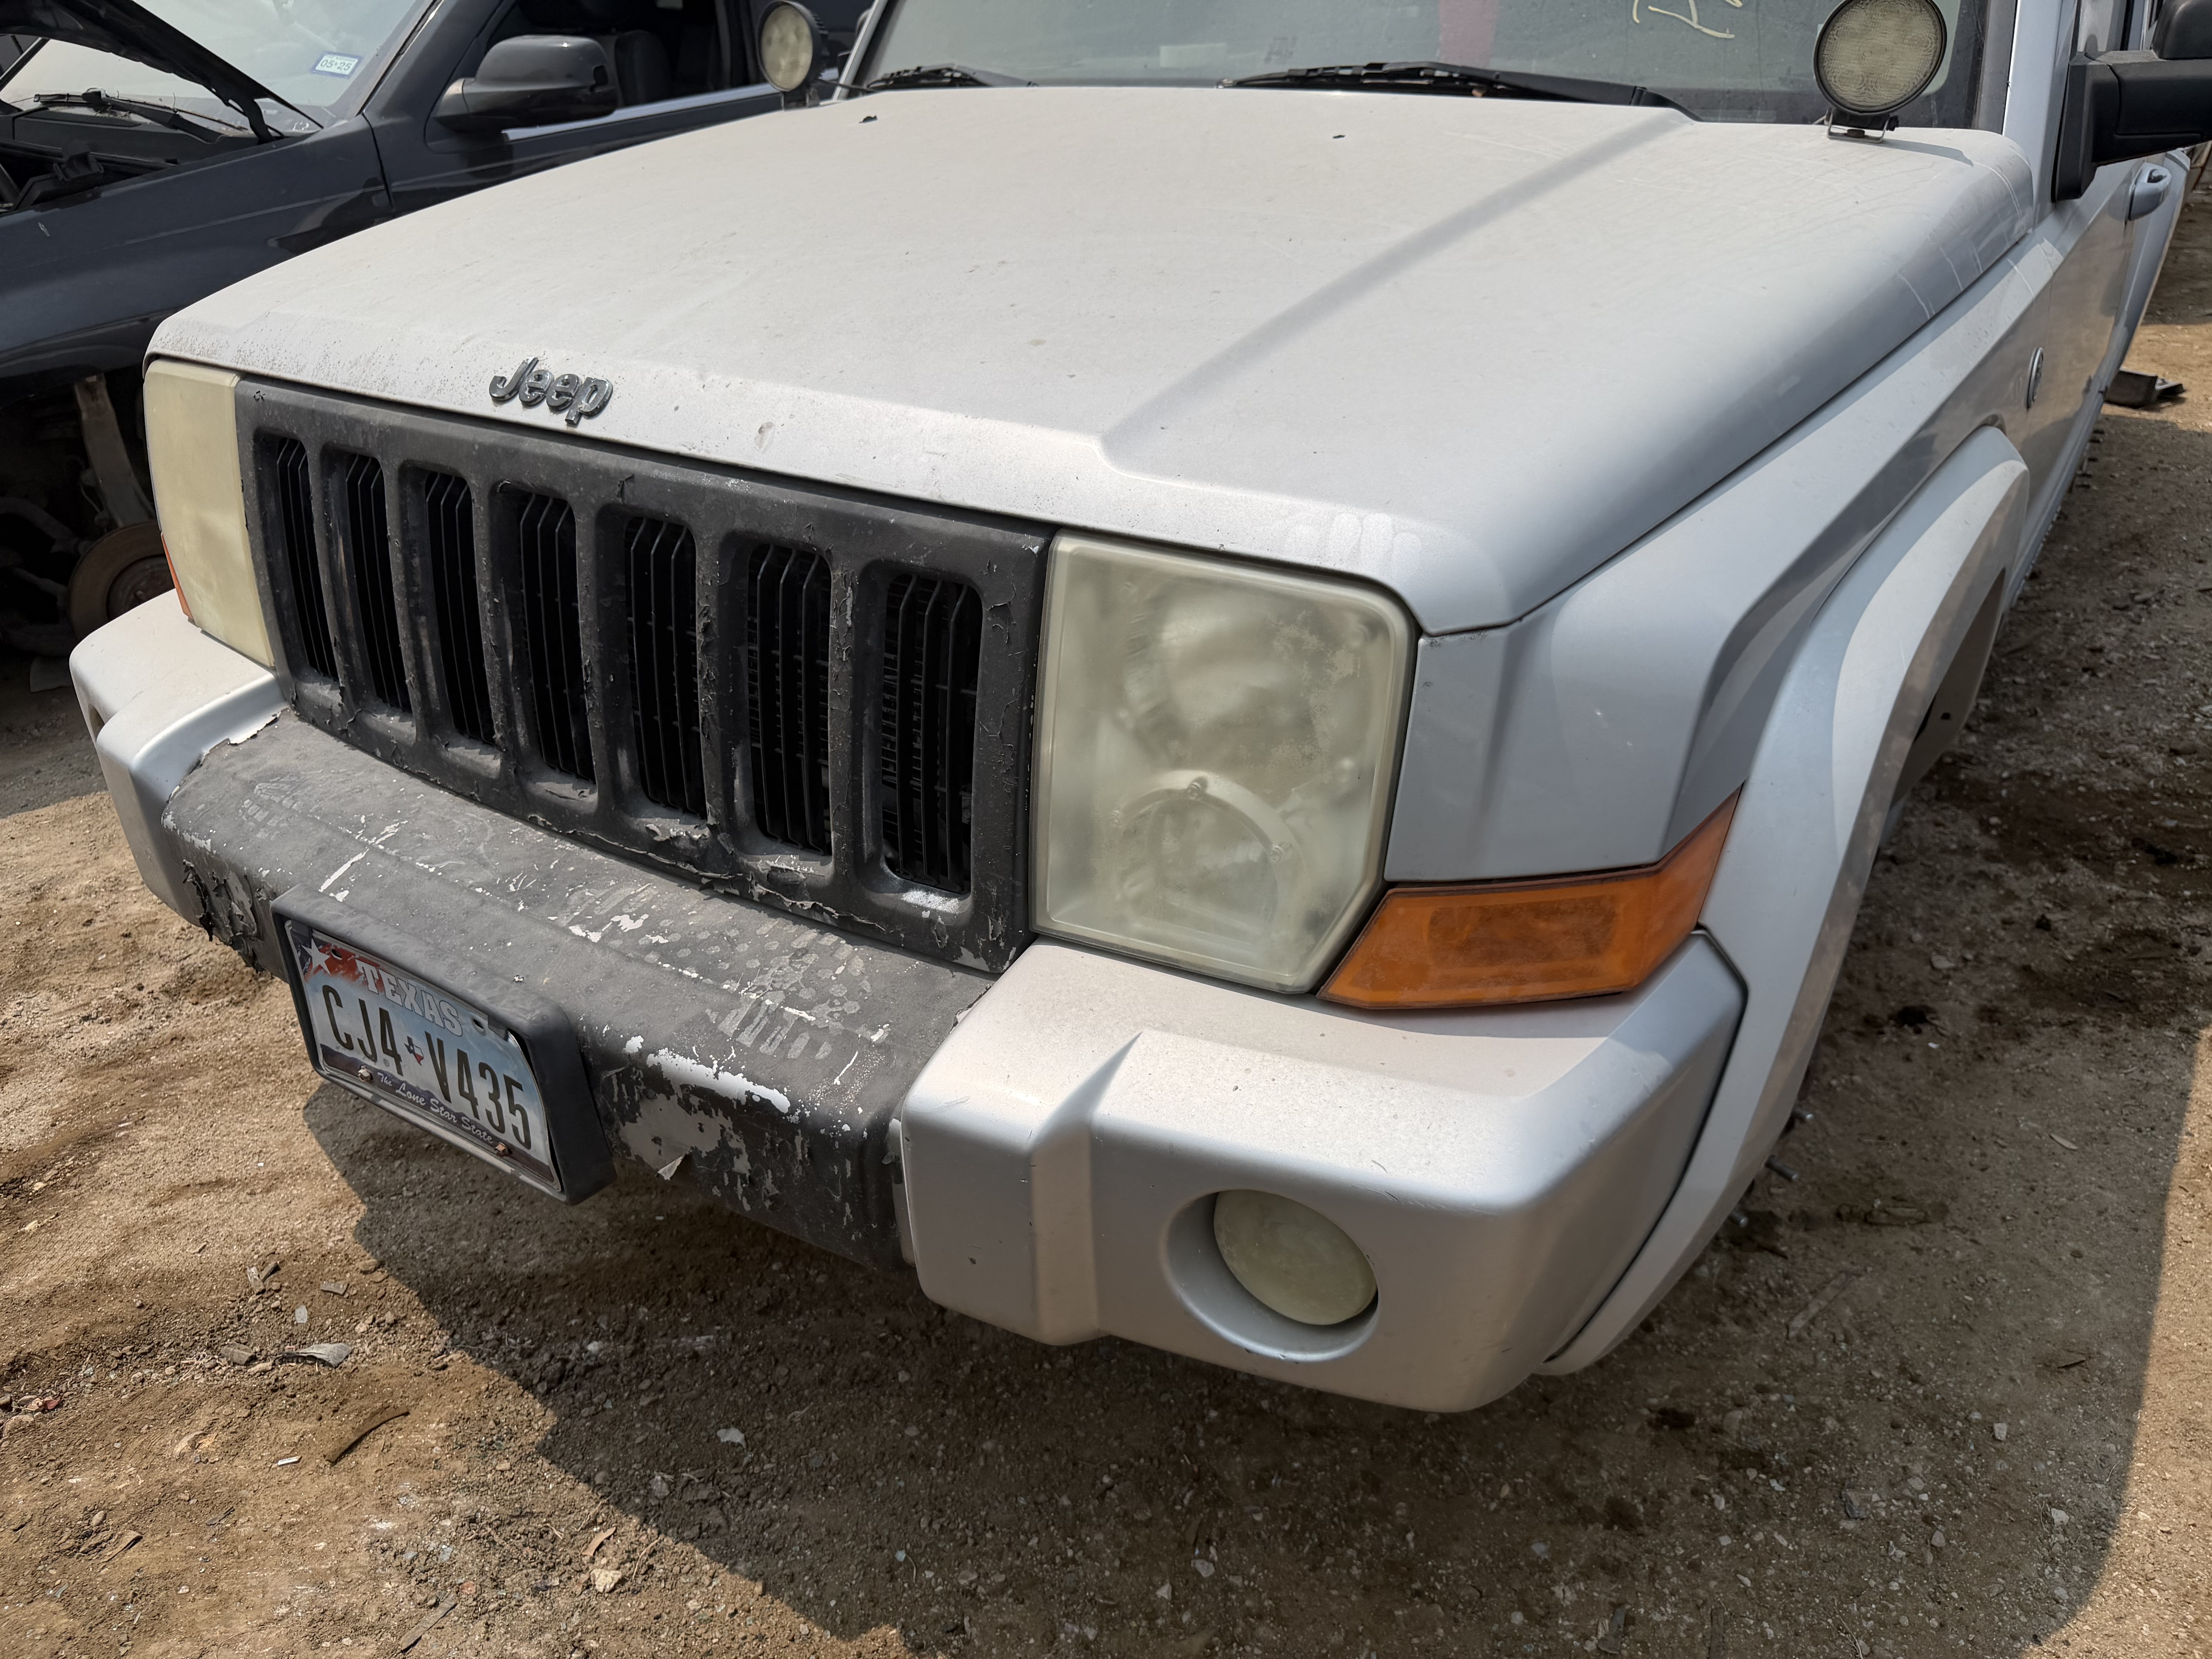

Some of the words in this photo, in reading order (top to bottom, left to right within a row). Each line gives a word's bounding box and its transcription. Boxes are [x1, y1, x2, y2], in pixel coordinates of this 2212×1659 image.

[489, 357, 613, 424] Jeep
[355, 959, 463, 1037] TEXAS
[377, 1072, 392, 1086] The
[395, 1083, 426, 1106] Lone
[430, 1097, 458, 1123] Star
[461, 1116, 494, 1144] State
